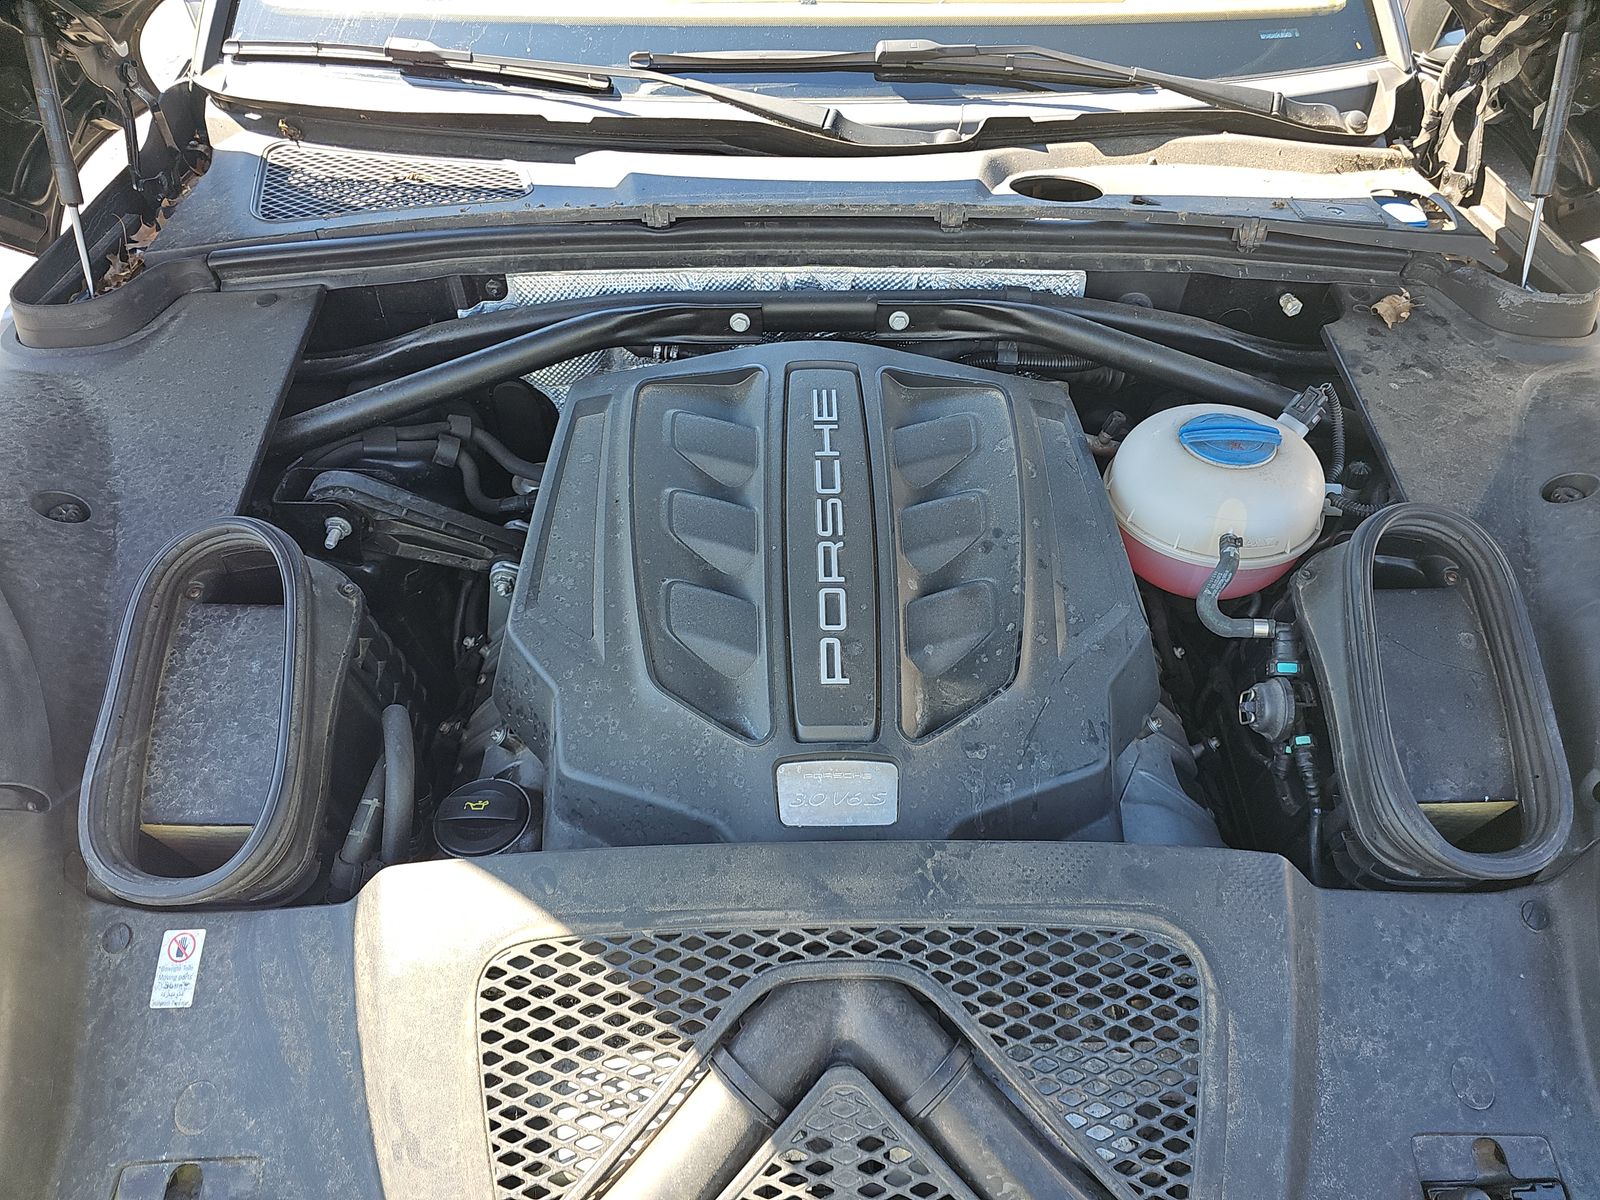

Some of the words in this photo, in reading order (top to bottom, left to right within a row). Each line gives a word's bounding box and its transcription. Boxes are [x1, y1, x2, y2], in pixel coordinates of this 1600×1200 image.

[813, 389, 850, 684] PORSCHE
[803, 772, 873, 780] PORSCHE
[789, 793, 827, 807] 3.0
[833, 791, 862, 806] V6
[863, 792, 888, 806] S
